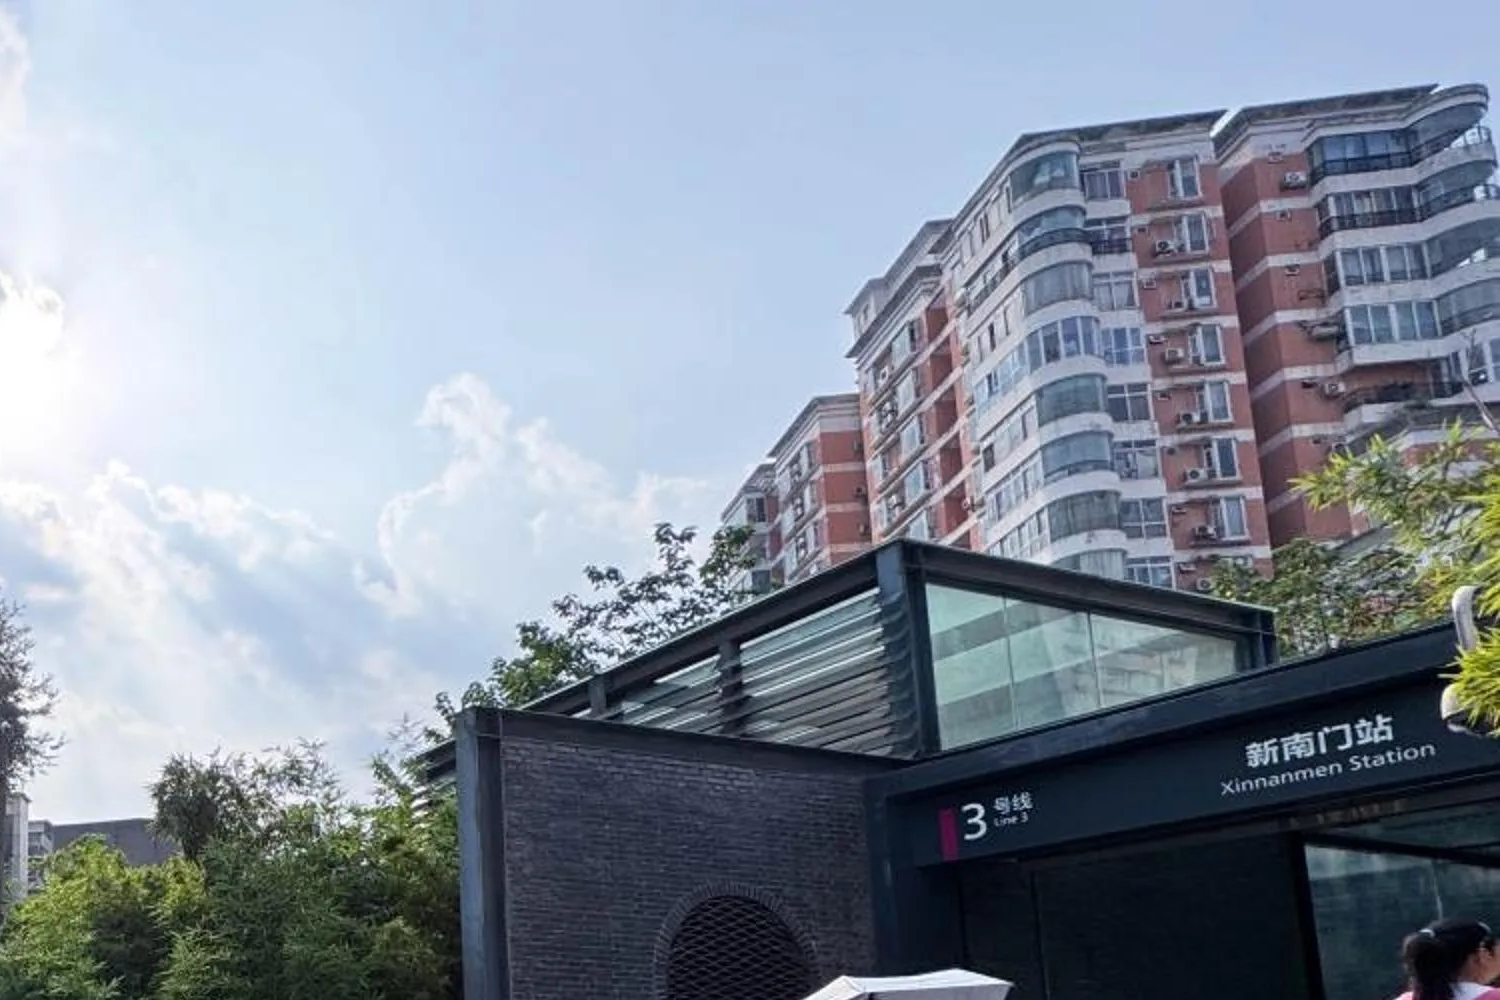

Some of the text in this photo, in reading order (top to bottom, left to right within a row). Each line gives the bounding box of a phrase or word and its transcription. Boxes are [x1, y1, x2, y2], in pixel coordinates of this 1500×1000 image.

[1245, 714, 1393, 768] 新南门站
[1220, 743, 1436, 796] Xinnanmen Station
[961, 792, 1033, 840] 3 号线
